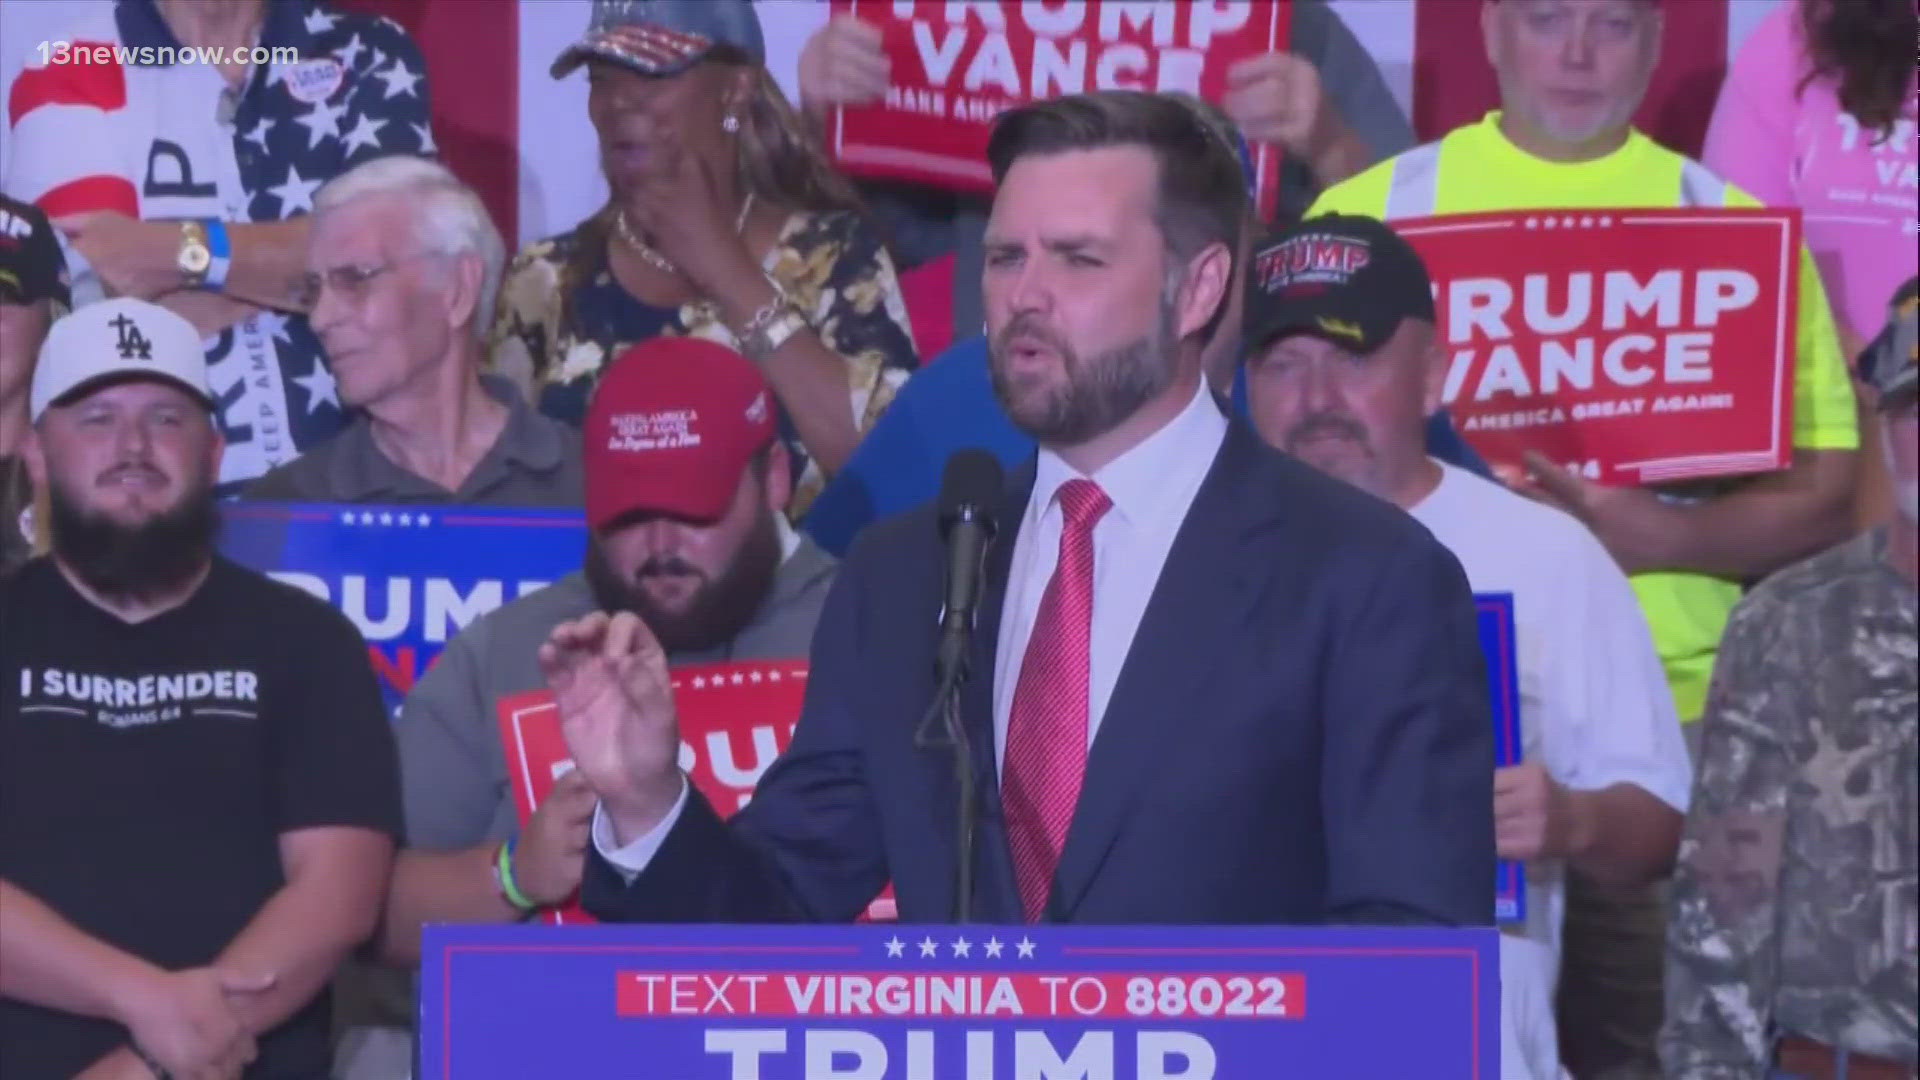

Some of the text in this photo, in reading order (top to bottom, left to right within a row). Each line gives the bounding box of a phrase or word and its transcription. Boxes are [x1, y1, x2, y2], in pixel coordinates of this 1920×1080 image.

[1256, 240, 1370, 288] TRUMP
[1432, 269, 1760, 343] RUMP
[1464, 407, 1566, 432] AMERICA
[1571, 398, 1647, 421] GREAT
[21, 667, 258, 707] I SURRENDER
[636, 976, 1286, 1015] TEXT VIRGINIA TO 88022
[704, 1029, 1218, 1080] TRUMP
